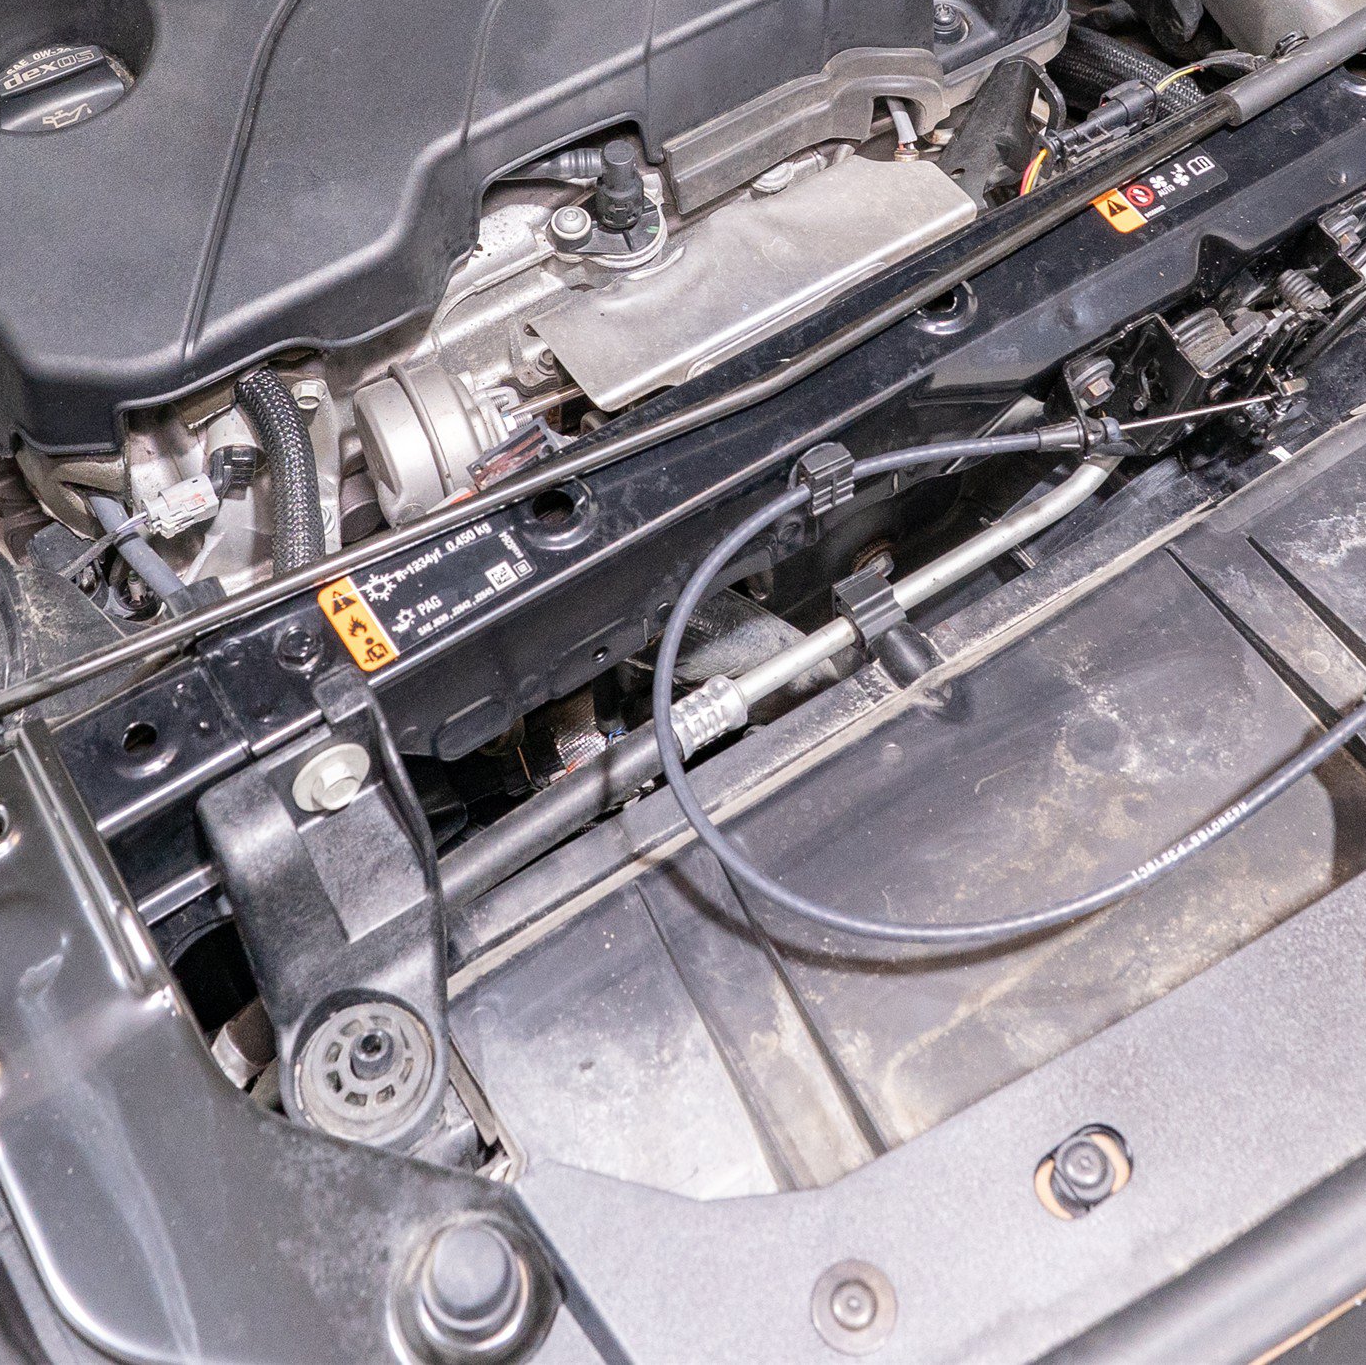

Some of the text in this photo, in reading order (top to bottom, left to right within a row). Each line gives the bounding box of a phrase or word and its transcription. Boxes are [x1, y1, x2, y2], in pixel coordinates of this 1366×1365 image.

[3, 50, 95, 90] dexos
[445, 528, 476, 552] 0.450
[473, 522, 493, 536] kg
[416, 595, 443, 616] PAG
